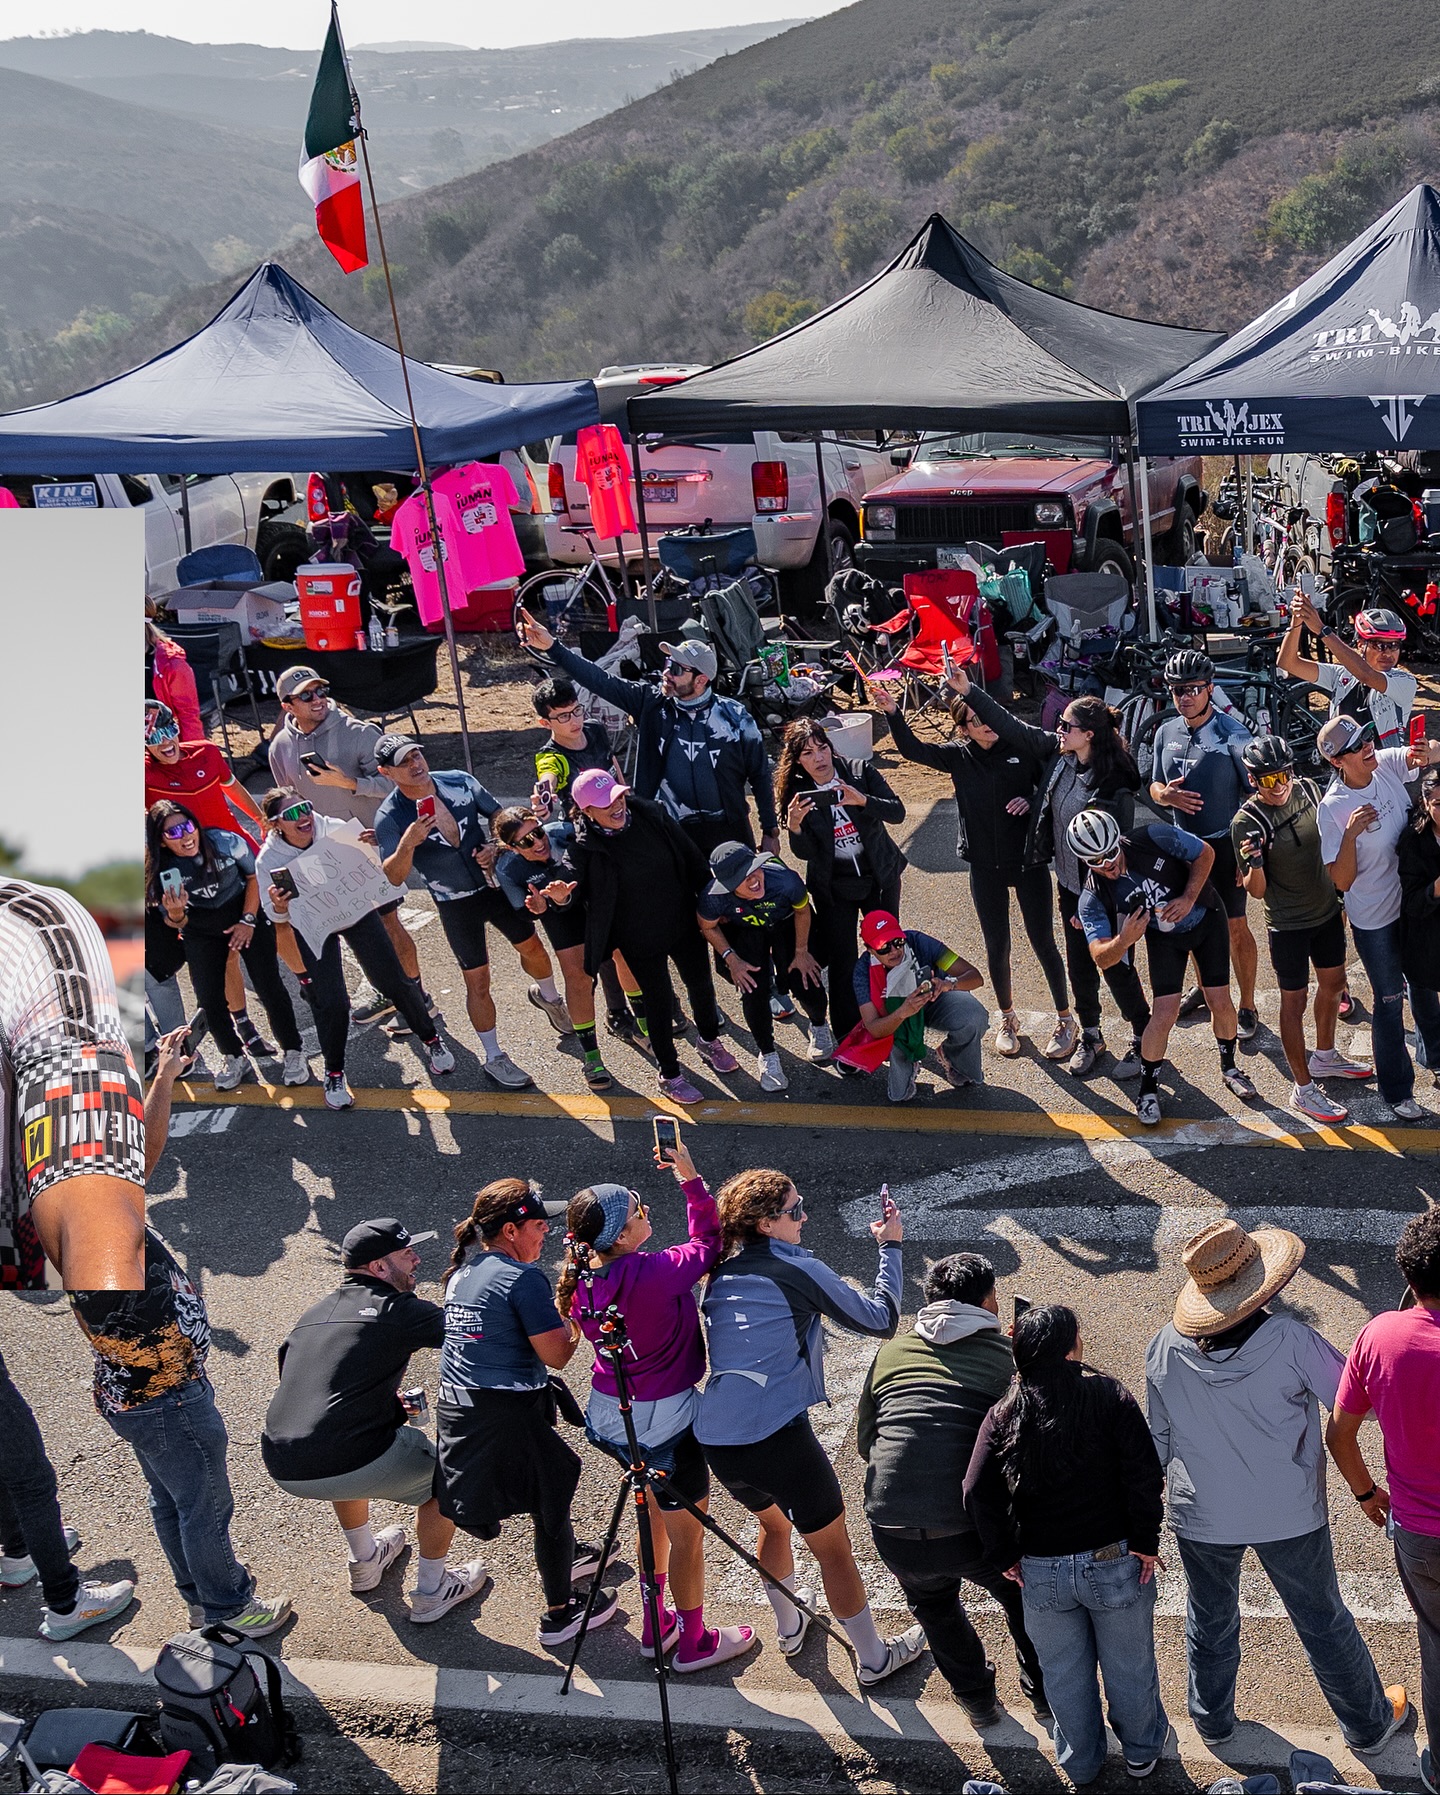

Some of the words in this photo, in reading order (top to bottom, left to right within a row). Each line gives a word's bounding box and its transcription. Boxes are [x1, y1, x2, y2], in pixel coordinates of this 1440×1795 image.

[1312, 323, 1374, 348] TRI
[1177, 415, 1212, 432] TRI
[1248, 413, 1284, 431] JEX
[1180, 436, 1284, 448] SWIM-BIKE-RUN
[38, 485, 93, 498] KING
[595, 777, 610, 789] alo
